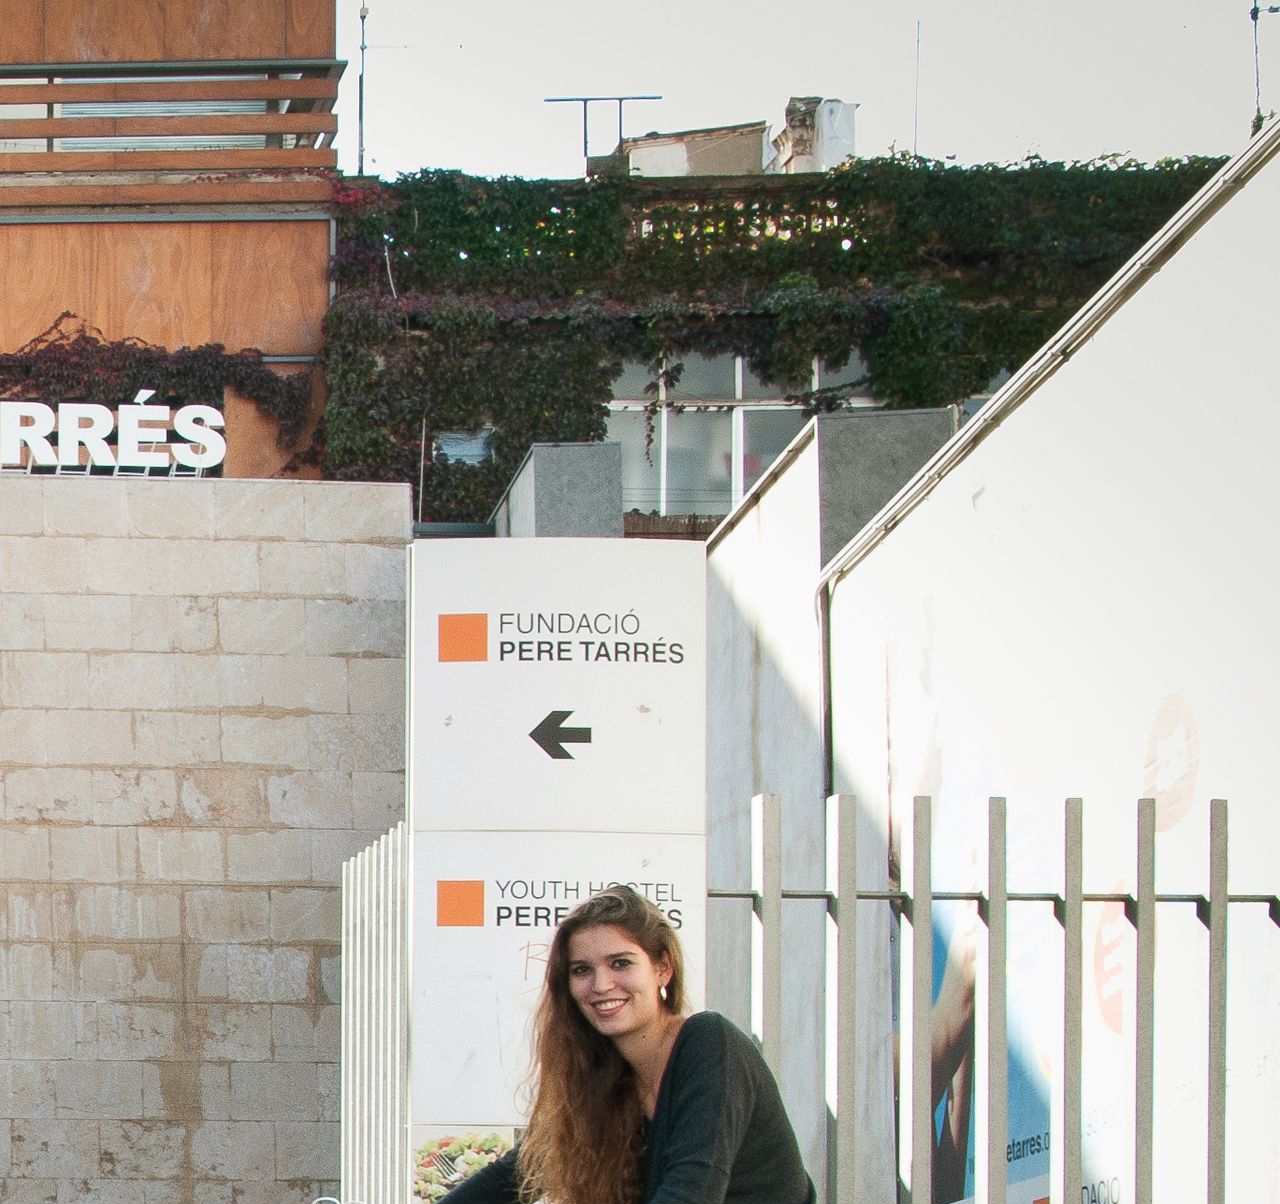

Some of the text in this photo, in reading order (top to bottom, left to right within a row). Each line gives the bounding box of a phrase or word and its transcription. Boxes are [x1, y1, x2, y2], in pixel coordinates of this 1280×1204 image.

[499, 608, 640, 635] FUNDACIÓ
[499, 637, 685, 664] PERE TARRÉS
[495, 880, 683, 902] YOUTH HTEL
